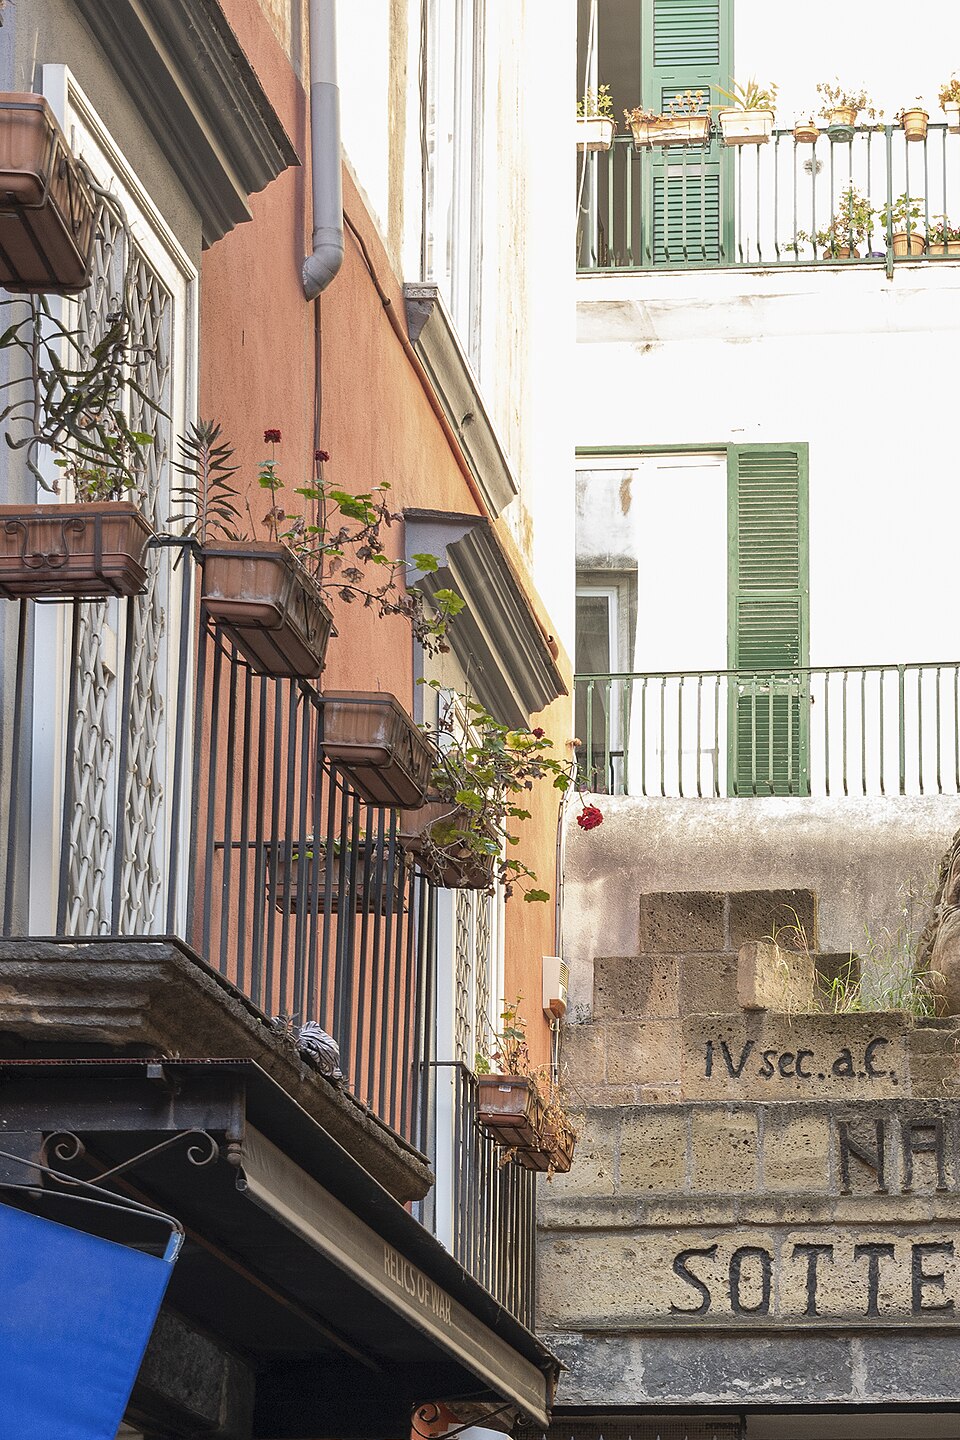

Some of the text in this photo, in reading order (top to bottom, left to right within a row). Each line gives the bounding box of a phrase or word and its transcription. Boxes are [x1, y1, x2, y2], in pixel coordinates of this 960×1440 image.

[759, 1047, 826, 1080] sec.
[384, 1244, 452, 1327] RELICS OF WAR
